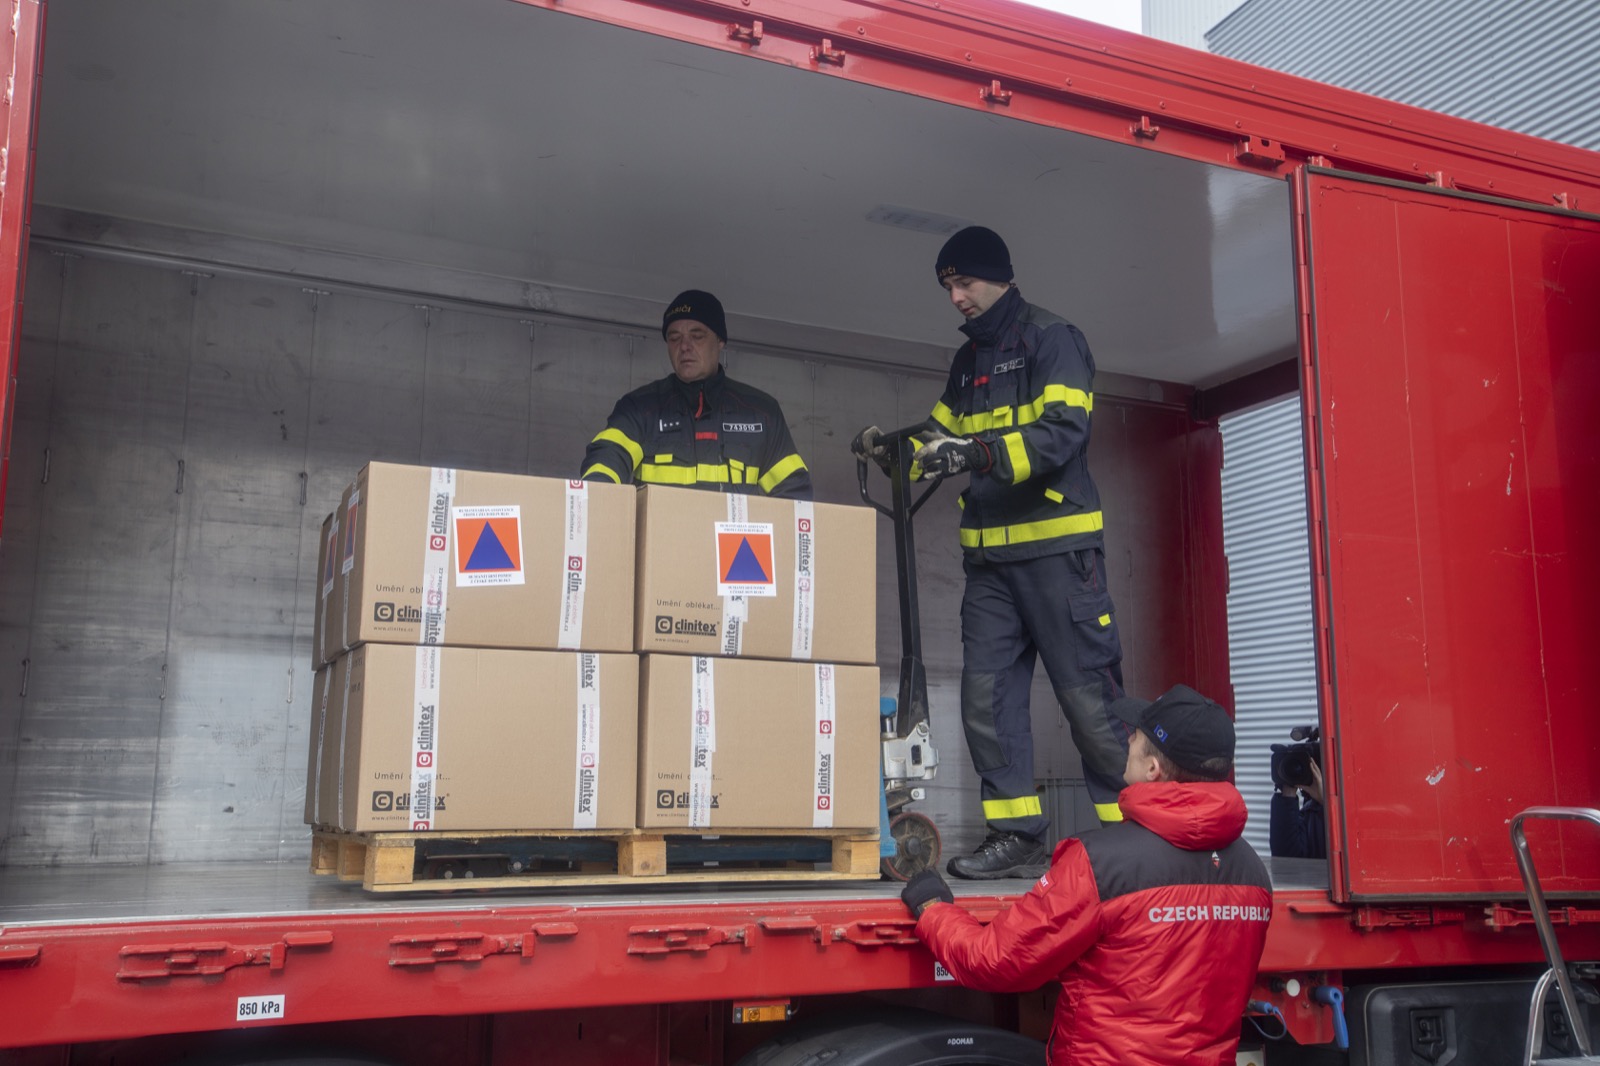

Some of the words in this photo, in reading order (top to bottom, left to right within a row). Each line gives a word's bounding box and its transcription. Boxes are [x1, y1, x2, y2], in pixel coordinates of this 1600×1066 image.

[432, 492, 446, 534] clinitex
[801, 533, 811, 572] clinitex
[375, 583, 404, 593] Umění
[656, 598, 681, 608] Umění
[675, 618, 717, 633] clinitex
[418, 705, 431, 750] clinitex
[374, 771, 404, 780] Umění
[657, 772, 683, 780] Umění
[817, 754, 828, 795] clinitex
[582, 769, 594, 813] clinitex
[1148, 905, 1209, 923] CZECH
[1213, 905, 1271, 921] REPUBLIC
[239, 1002, 258, 1015] 850
[261, 1001, 280, 1014] kPa
